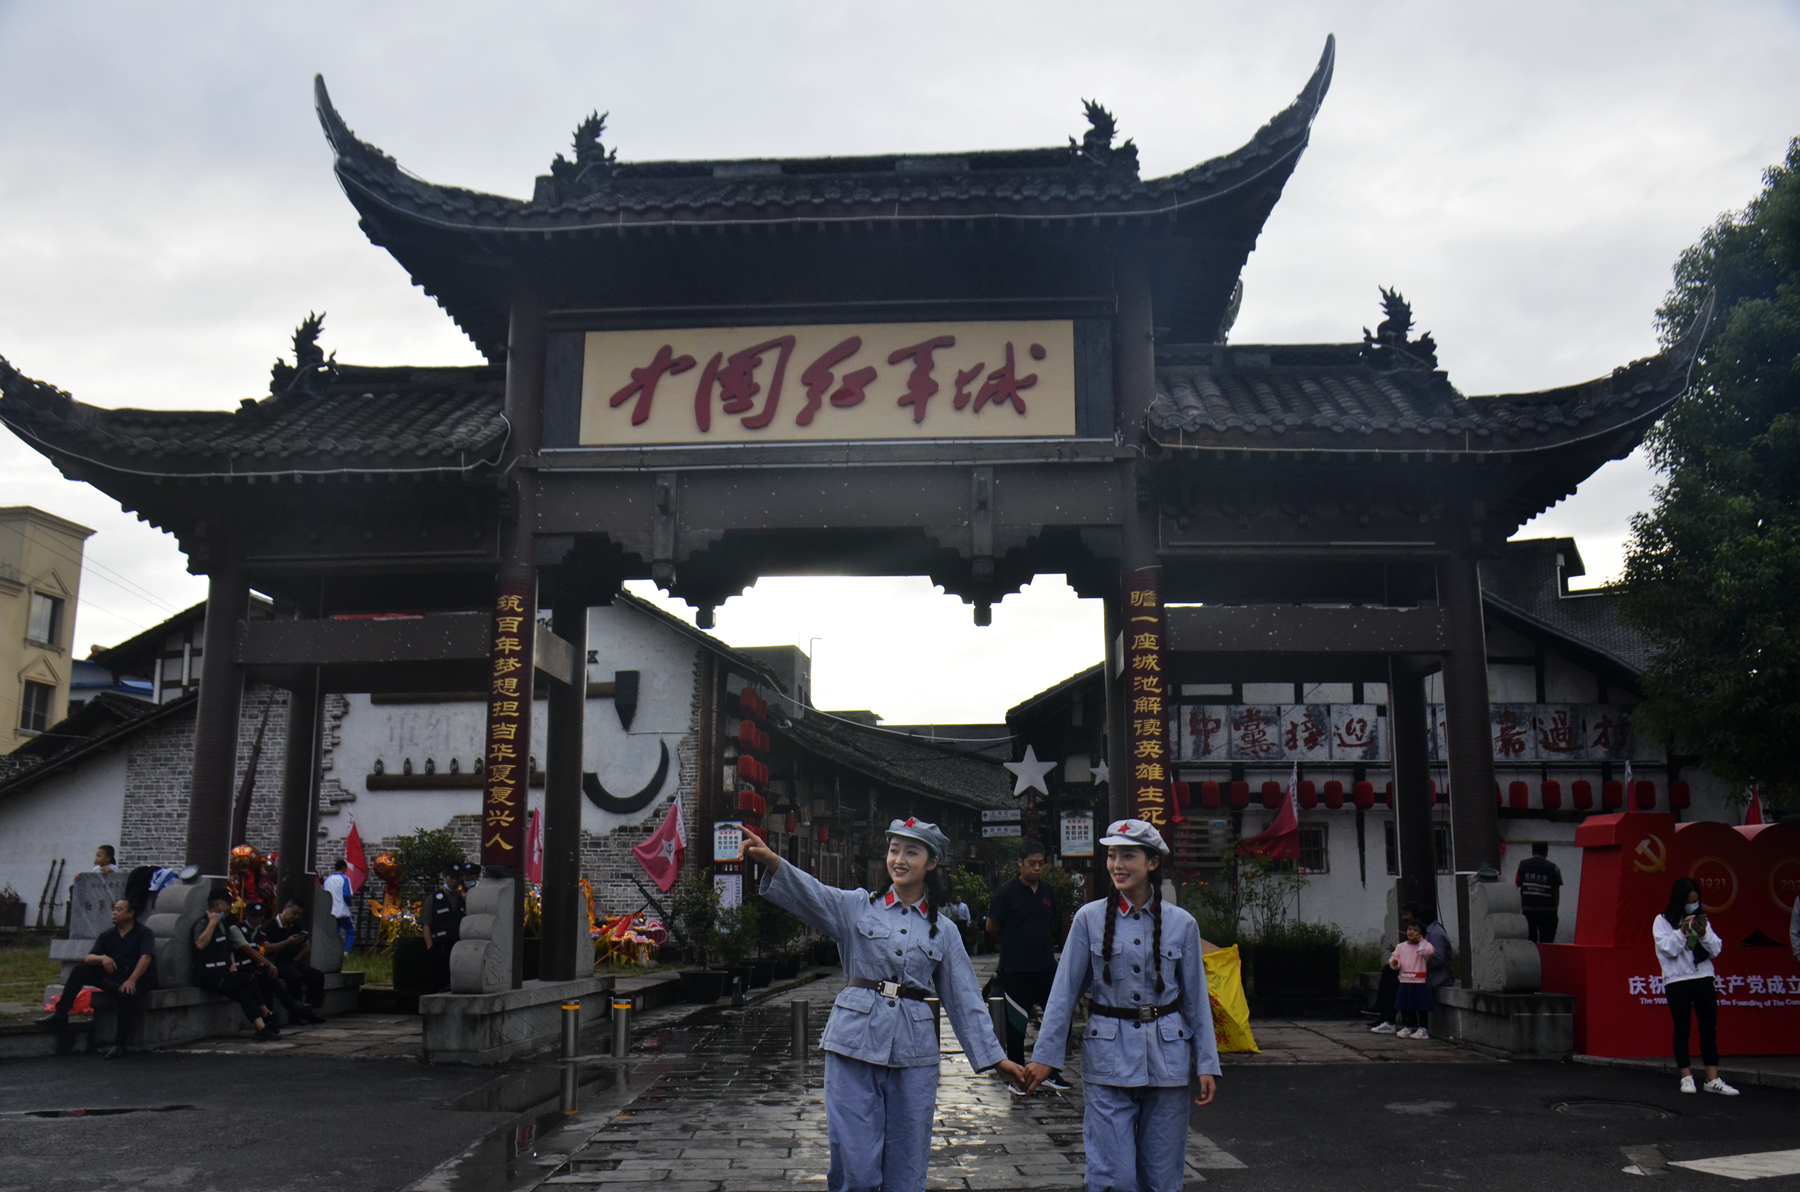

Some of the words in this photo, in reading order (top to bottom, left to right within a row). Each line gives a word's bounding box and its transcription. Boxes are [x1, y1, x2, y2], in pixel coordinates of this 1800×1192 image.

[485, 594, 524, 851] 筑百年梦想担当华夏复兴人
[1130, 590, 1167, 833] 瞻一座城池解读英雄生死
[1700, 877, 1726, 890] 1921
[1628, 974, 1800, 996] 庆祝共产党成立
[1639, 997, 1653, 1005] The
[1720, 998, 1731, 1006] the
[1732, 999, 1763, 1009] Founding
